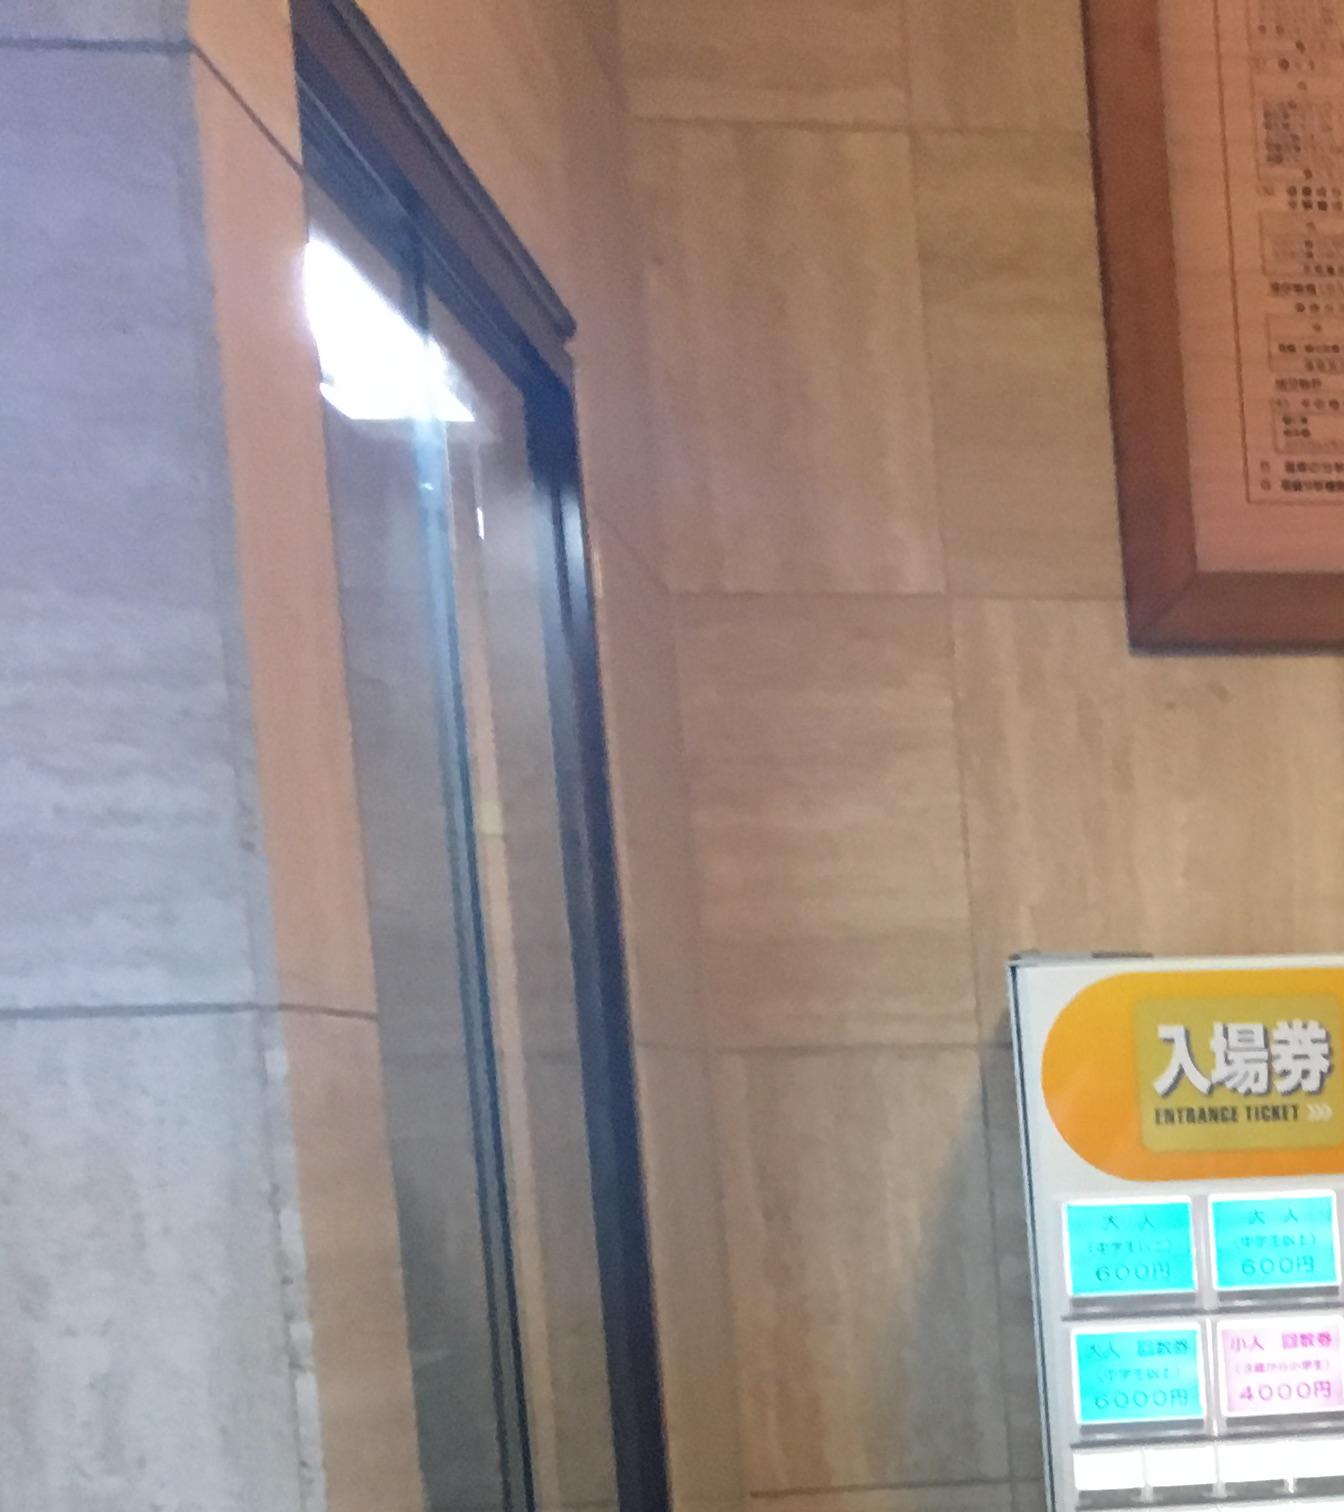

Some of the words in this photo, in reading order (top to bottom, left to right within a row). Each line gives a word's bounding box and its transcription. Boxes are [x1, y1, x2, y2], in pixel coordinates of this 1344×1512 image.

[1153, 1018, 1332, 1100] 入場券
[1154, 1104, 1240, 1127] ENTRANCE
[1244, 1102, 1301, 1123] TICKET
[1249, 1208, 1299, 1225] 大人
[1095, 1262, 1171, 1282] 600円
[1241, 1255, 1315, 1276] 600円
[1230, 1335, 1265, 1352] 小人
[1094, 1388, 1188, 1409] 6000円
[1240, 1380, 1332, 1401] 4000円
